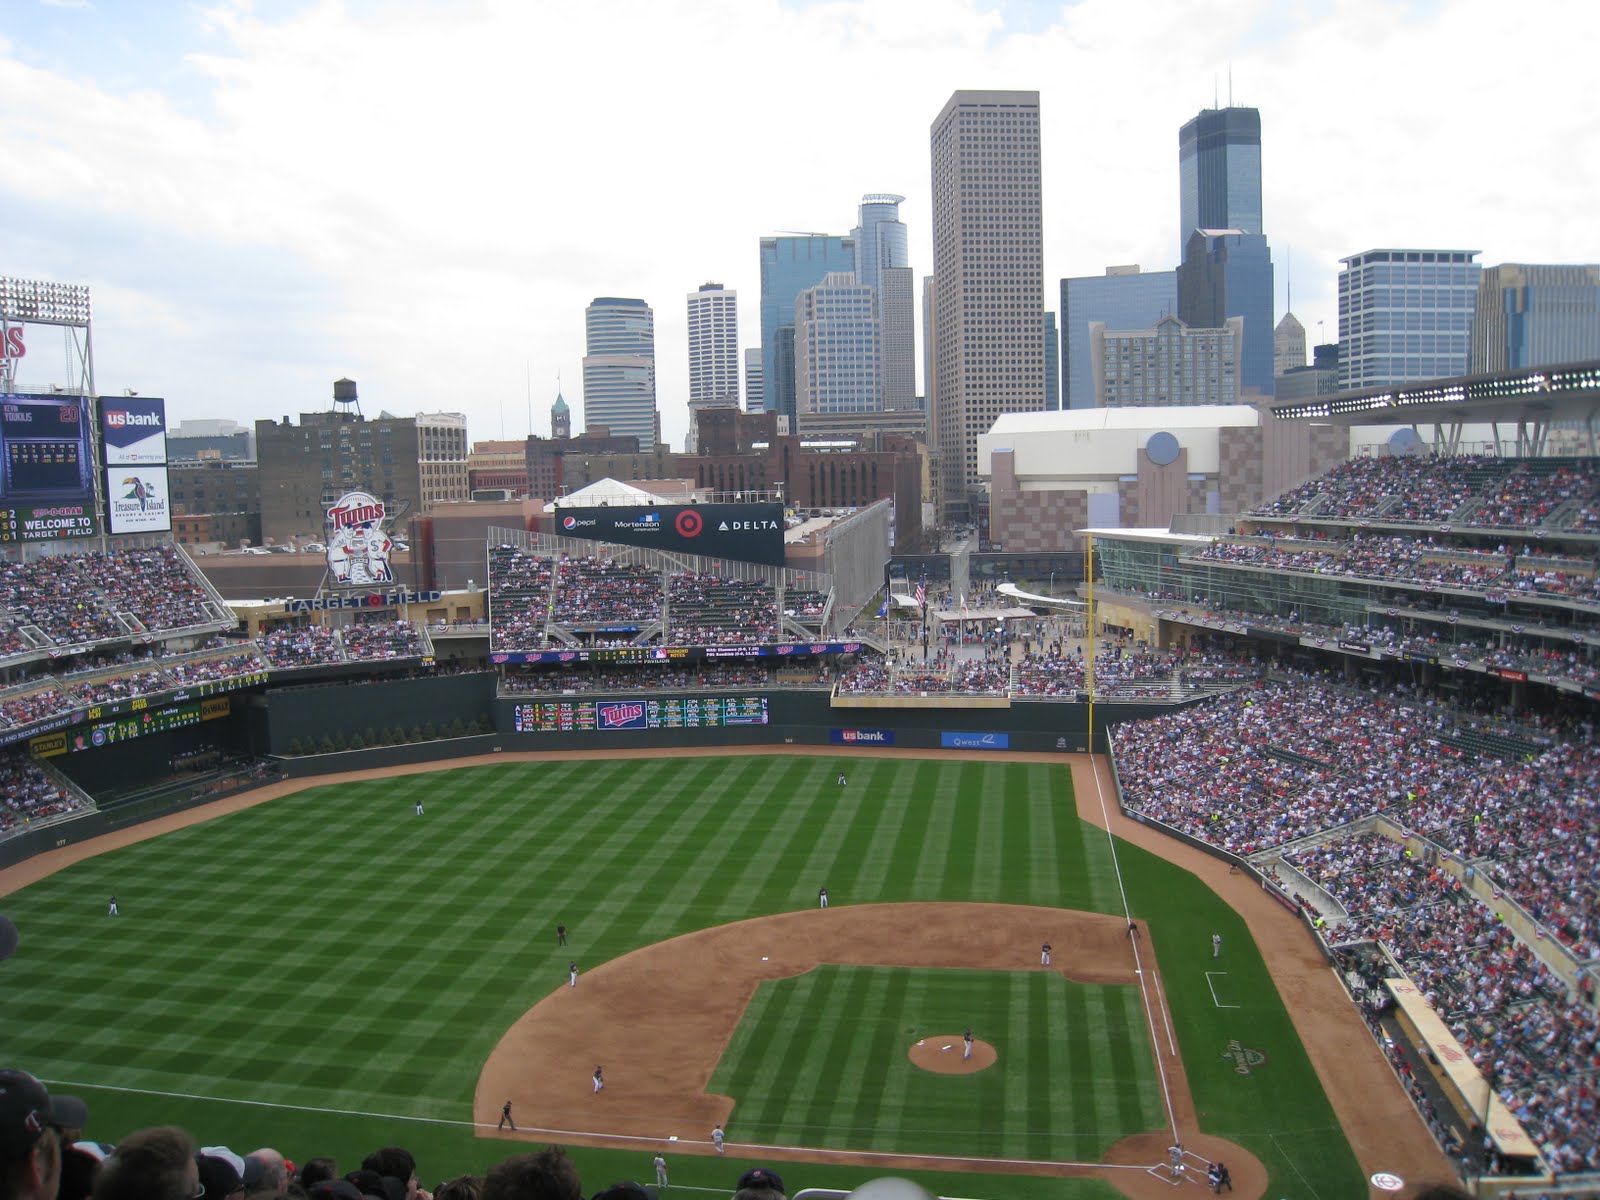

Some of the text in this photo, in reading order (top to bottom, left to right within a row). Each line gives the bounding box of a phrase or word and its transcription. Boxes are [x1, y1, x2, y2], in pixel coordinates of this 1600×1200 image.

[60, 405, 78, 422] 20
[114, 499, 164, 512] Treasure Island
[9, 510, 16, 518] 2
[328, 502, 384, 530] Twins
[10, 521, 16, 529] 0
[25, 518, 90, 530] WELCOME TO
[733, 520, 778, 530] DELTA
[12, 532, 16, 540] 1
[23, 530, 59, 538] TARGET
[287, 591, 442, 612] TARGET FIELD
[600, 704, 642, 726] Twins
[18, 727, 39, 740] SECURE
[40, 722, 54, 733] YOUR
[843, 731, 884, 741] usbank
[34, 740, 64, 752] STANLEY
